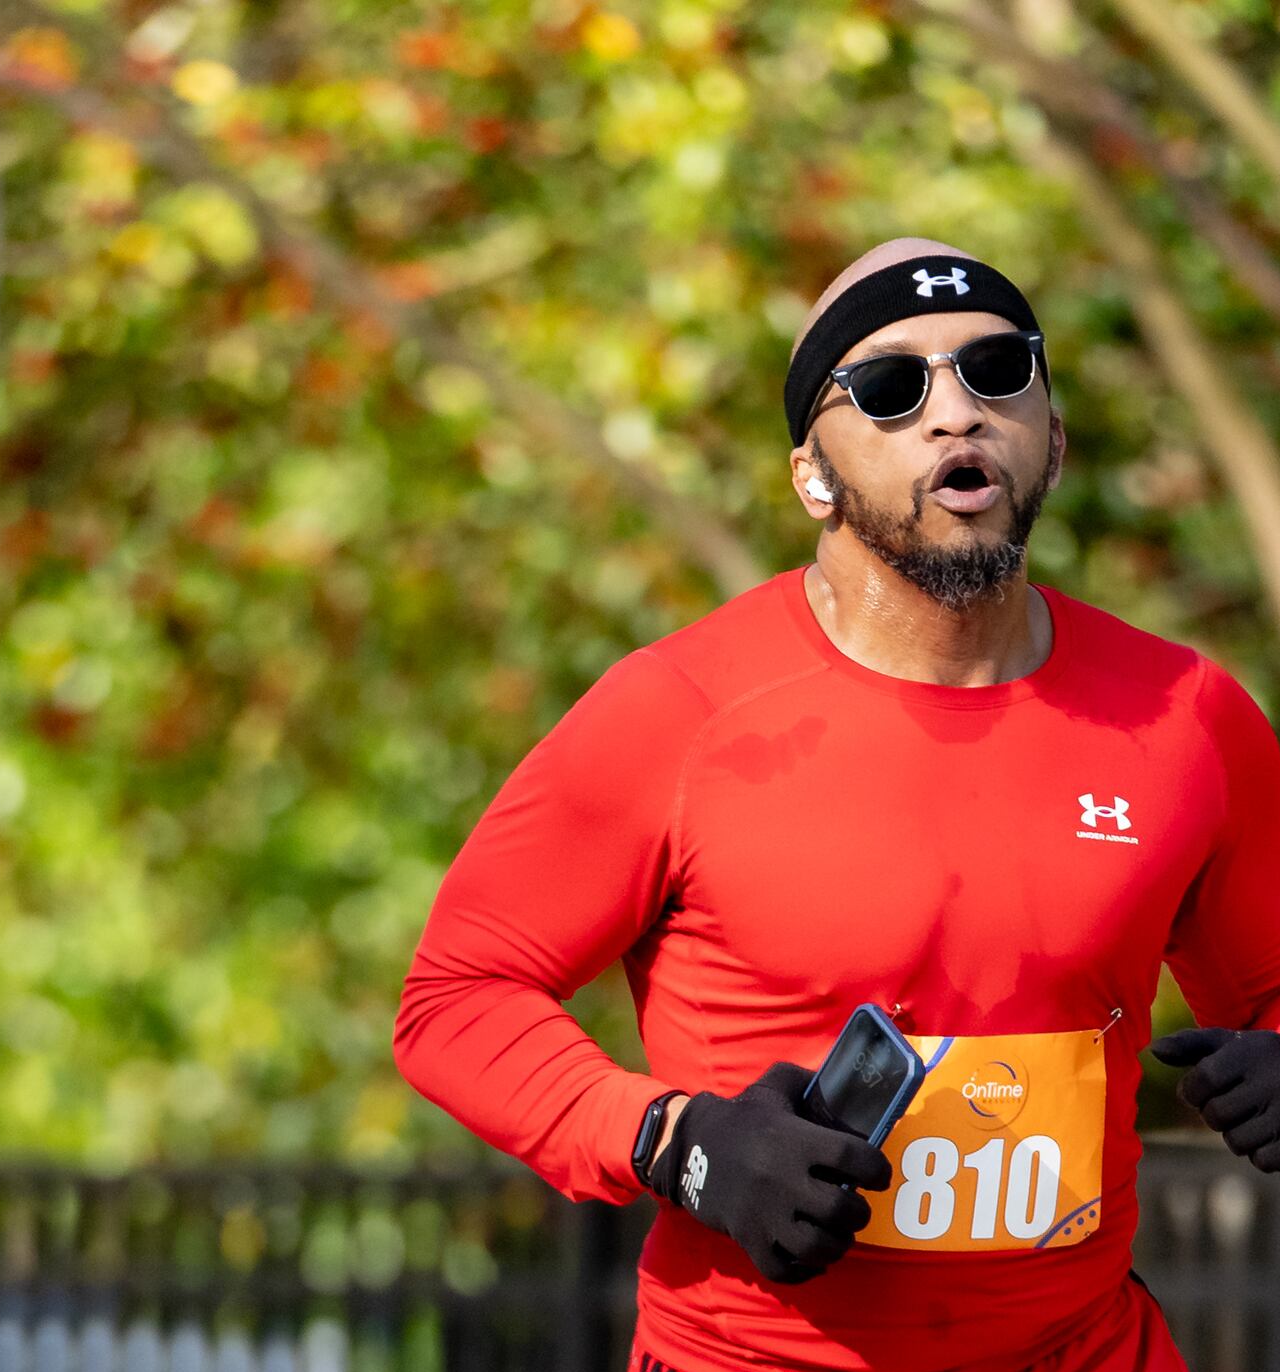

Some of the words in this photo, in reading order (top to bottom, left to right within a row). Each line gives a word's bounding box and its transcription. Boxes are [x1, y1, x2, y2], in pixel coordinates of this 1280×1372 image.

[1076, 831, 1105, 841] UNDER
[853, 1052, 883, 1088] 9:37
[962, 1082, 1023, 1099] OnTime
[894, 1135, 1062, 1240] 810
